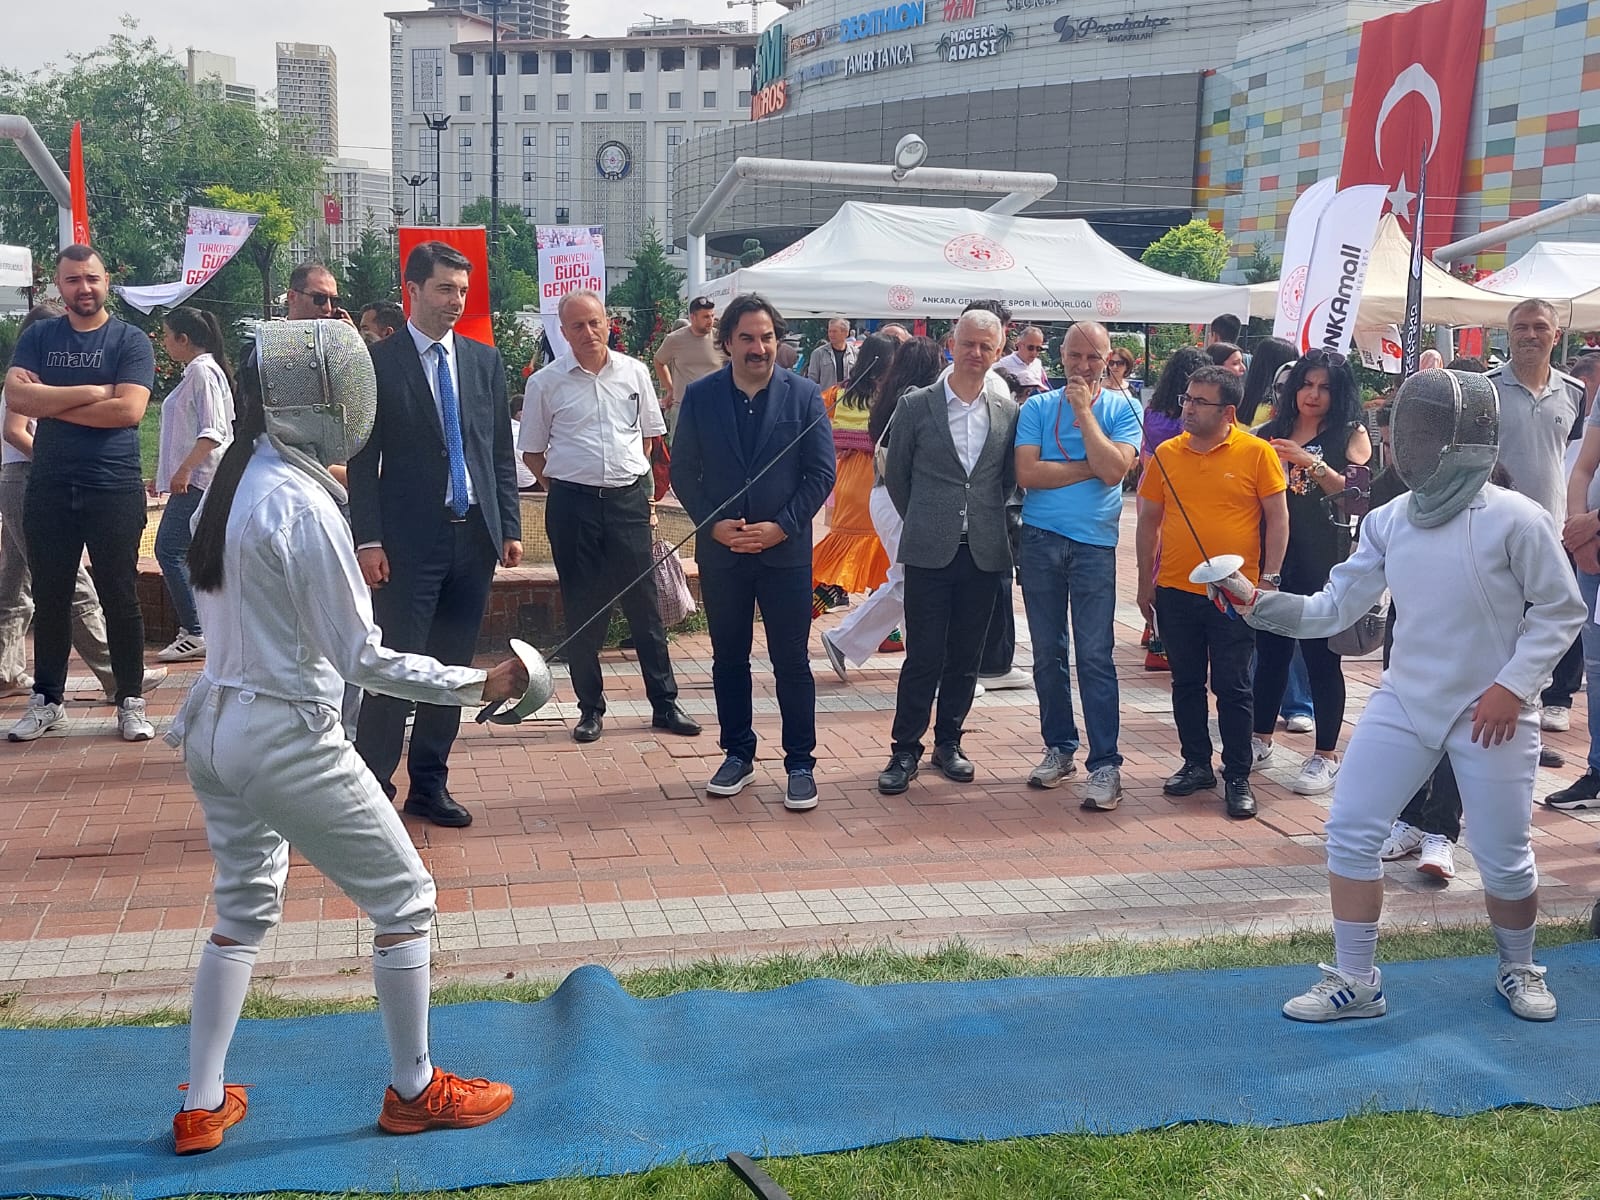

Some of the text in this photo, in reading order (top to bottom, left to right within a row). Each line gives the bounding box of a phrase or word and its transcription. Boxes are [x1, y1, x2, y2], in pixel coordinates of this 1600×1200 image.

[839, 0, 927, 43] DECATHLON
[950, 23, 997, 43] MACERA
[844, 43, 915, 77] TAMER TANCA
[948, 39, 998, 62] ADASI
[922, 296, 957, 305] ANKARA
[1008, 299, 1030, 307] SPOR
[47, 349, 103, 369] mavi
